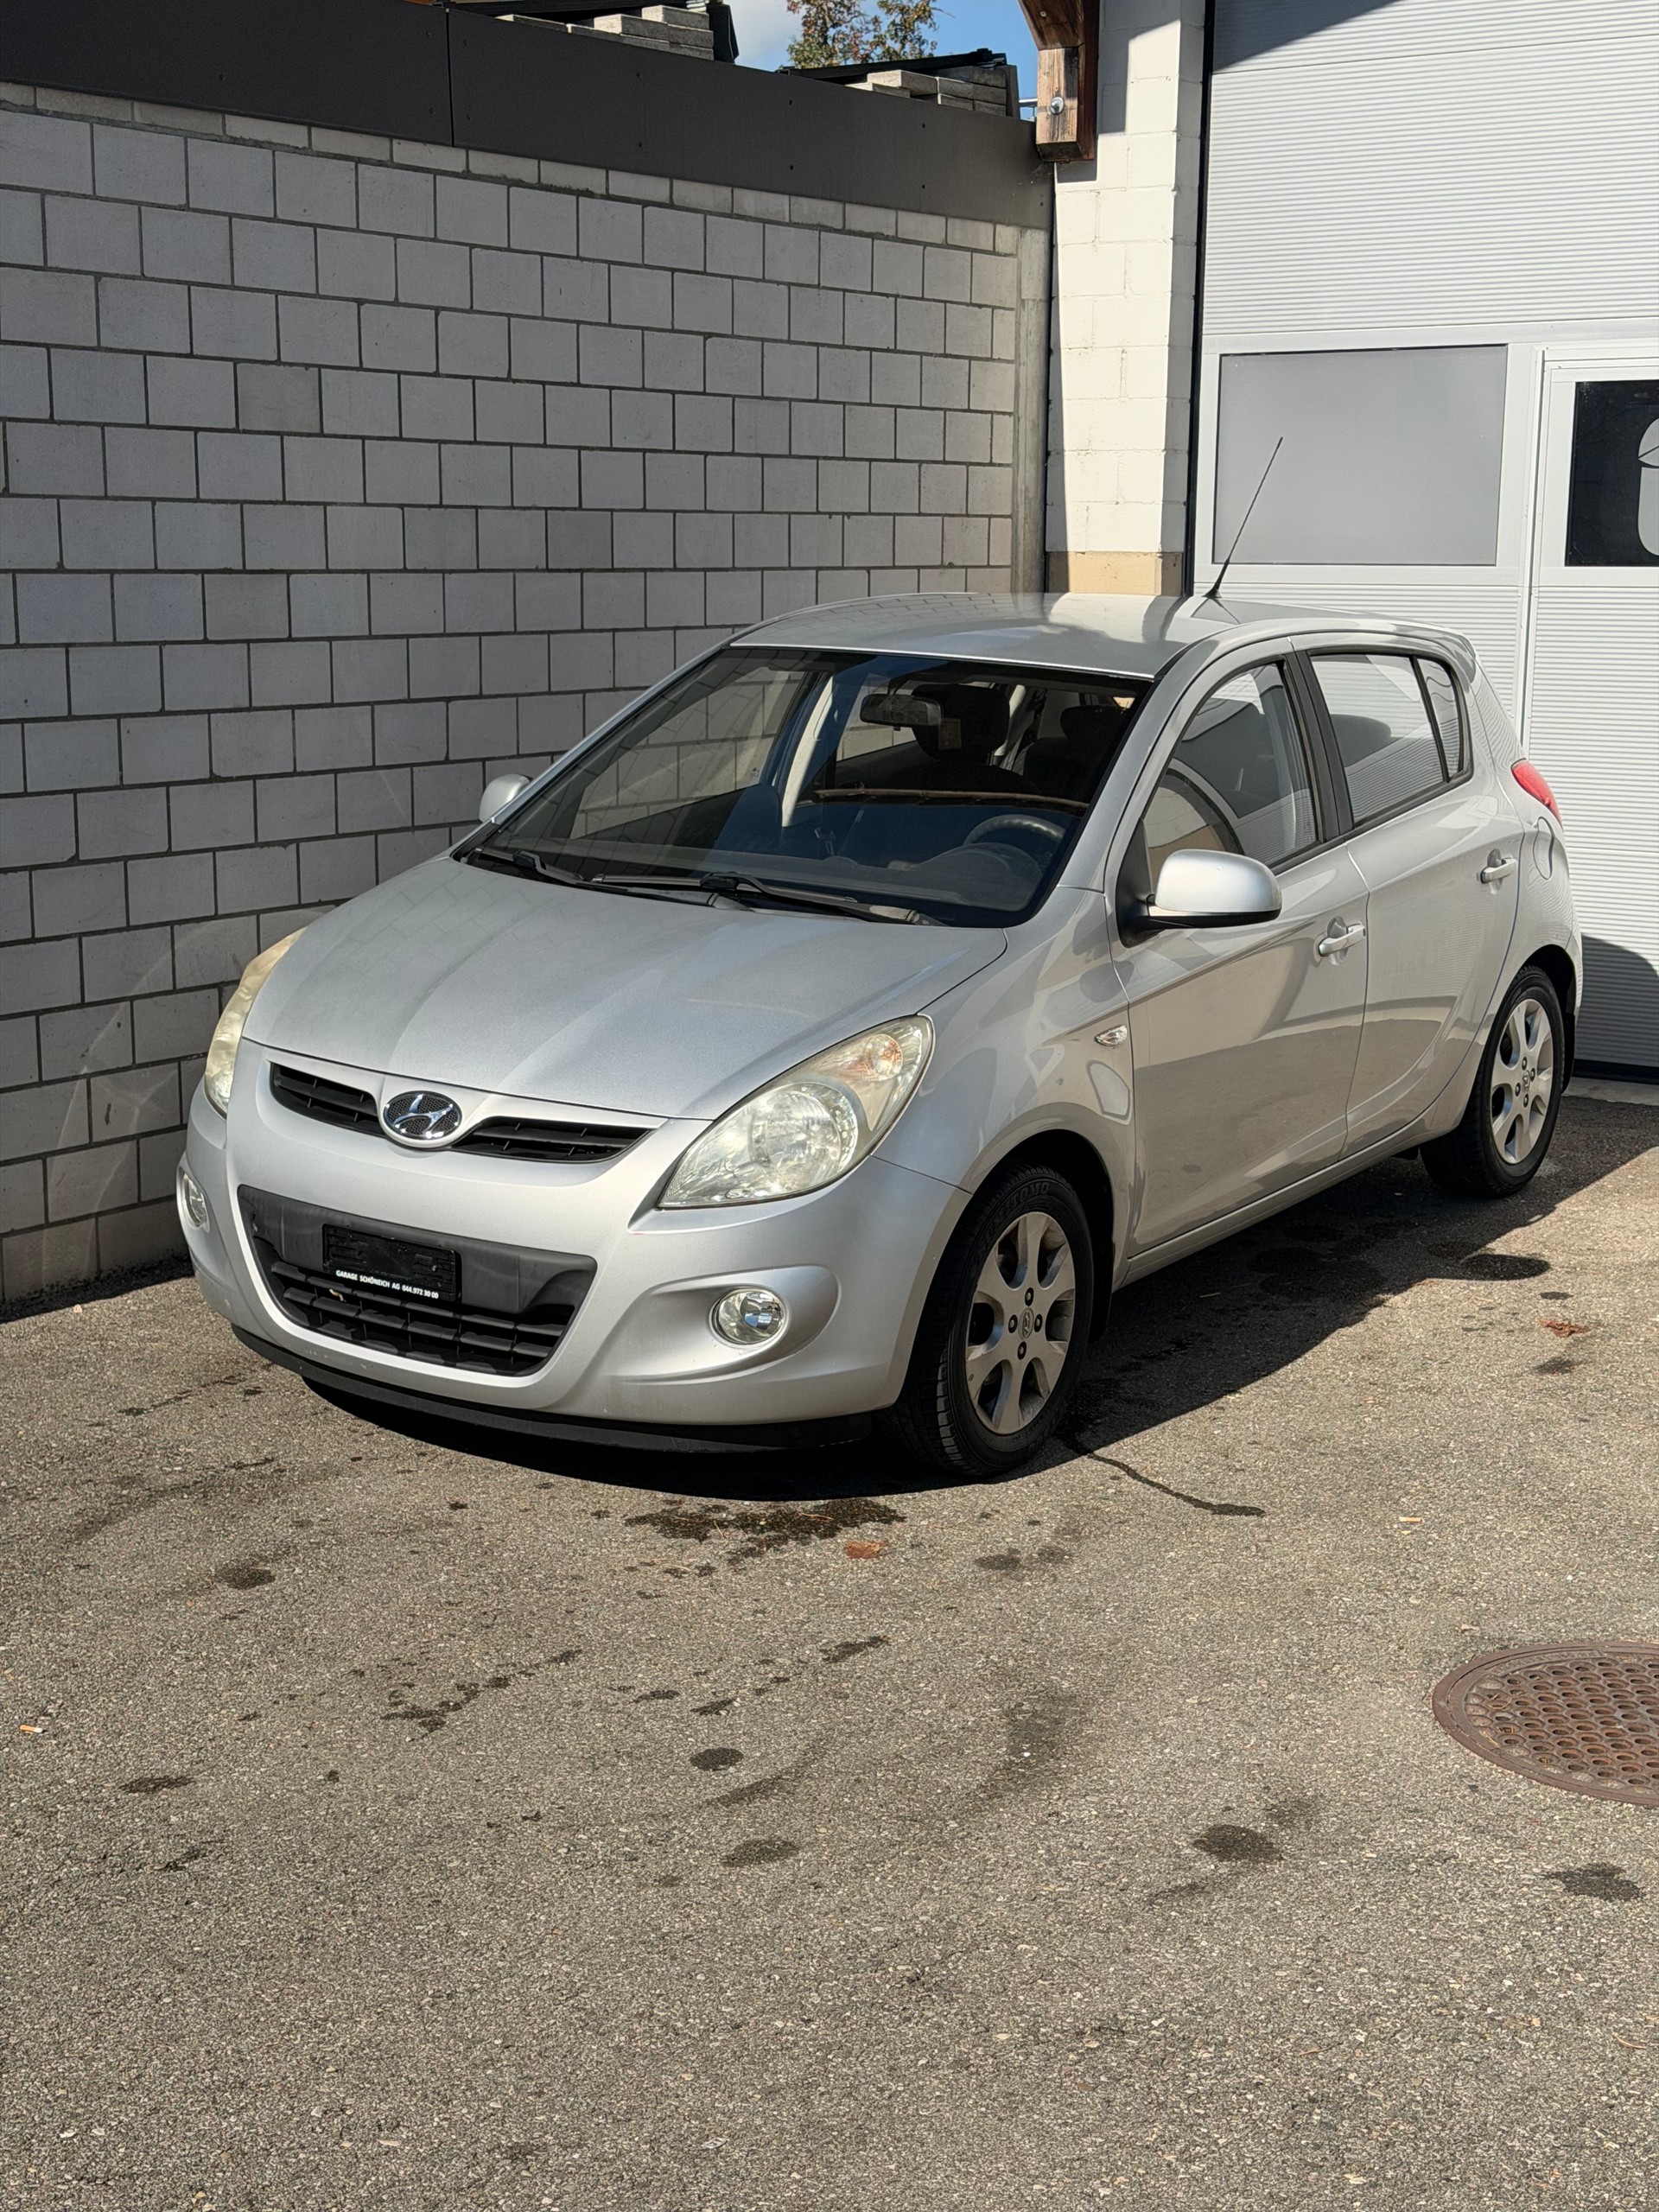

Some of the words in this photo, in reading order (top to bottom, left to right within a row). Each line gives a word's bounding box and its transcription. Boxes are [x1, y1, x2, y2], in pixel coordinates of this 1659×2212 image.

[335, 1269, 359, 1281] GARAGE
[359, 1274, 391, 1288] SCHÖNEICH
[391, 1282, 401, 1291] AG
[402, 1284, 424, 1296] 044.972
[431, 1291, 439, 1300] 00
